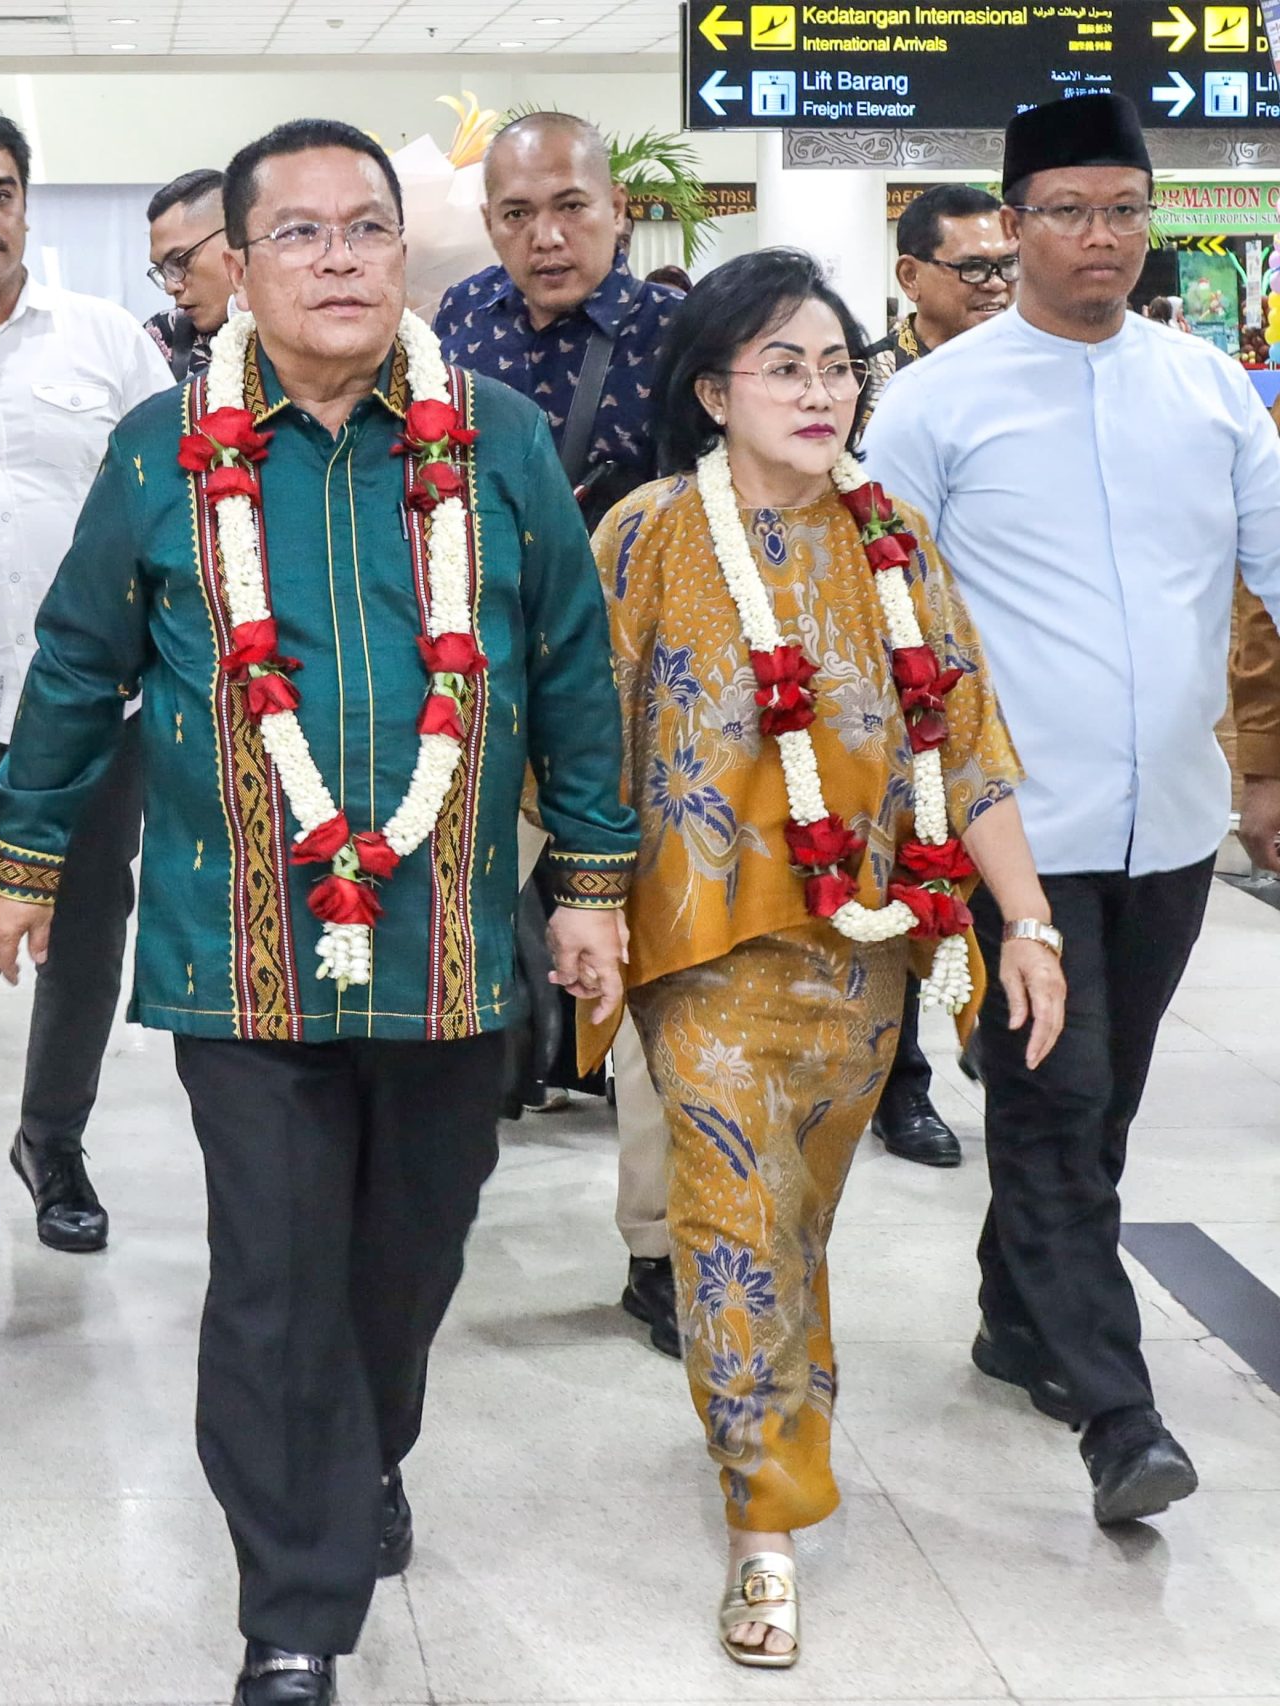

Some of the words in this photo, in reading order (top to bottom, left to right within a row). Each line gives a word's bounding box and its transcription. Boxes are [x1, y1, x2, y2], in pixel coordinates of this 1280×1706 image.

[802, 6, 910, 29] Kedatangan
[915, 6, 1028, 25] Internasional
[802, 36, 891, 51] International
[893, 36, 948, 51] Arrivals
[802, 71, 833, 91] Lift
[837, 71, 909, 95] Barang
[802, 101, 853, 119] Freight
[856, 101, 916, 117] Elevator
